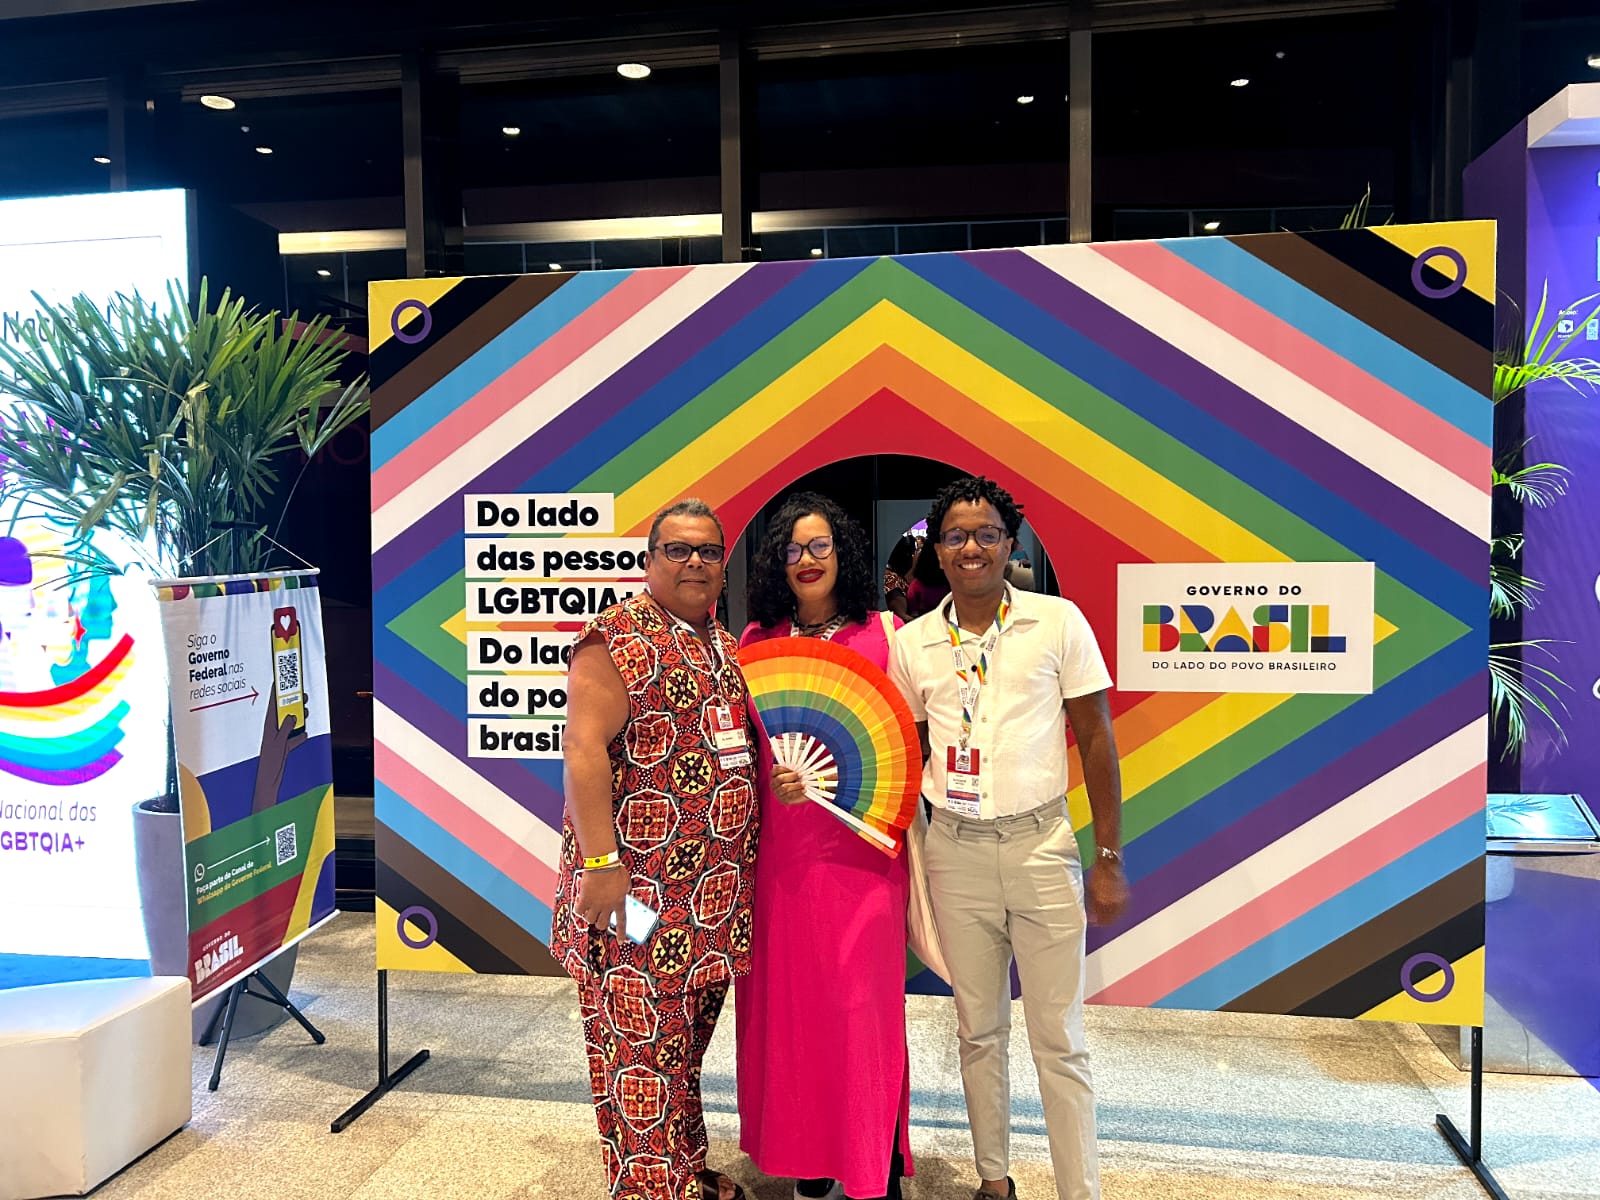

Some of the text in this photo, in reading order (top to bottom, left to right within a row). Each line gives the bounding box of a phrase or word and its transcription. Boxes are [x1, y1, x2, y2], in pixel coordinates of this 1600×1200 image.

[477, 499, 599, 527] Do lado
[477, 544, 535, 571] das
[1186, 585, 1302, 596] GOVERNO DO
[1143, 604, 1346, 653] BRASIL
[187, 633, 217, 650] Siga o
[479, 638, 523, 665] Do
[188, 648, 230, 665] Governo
[1152, 661, 1337, 672] DO LADO DO POVO BRASILEIRO
[189, 662, 245, 683] Federal nas
[190, 676, 246, 700] redes sociais
[478, 681, 520, 708] do
[69, 800, 97, 822] dos
[194, 934, 244, 985] BRASIL
